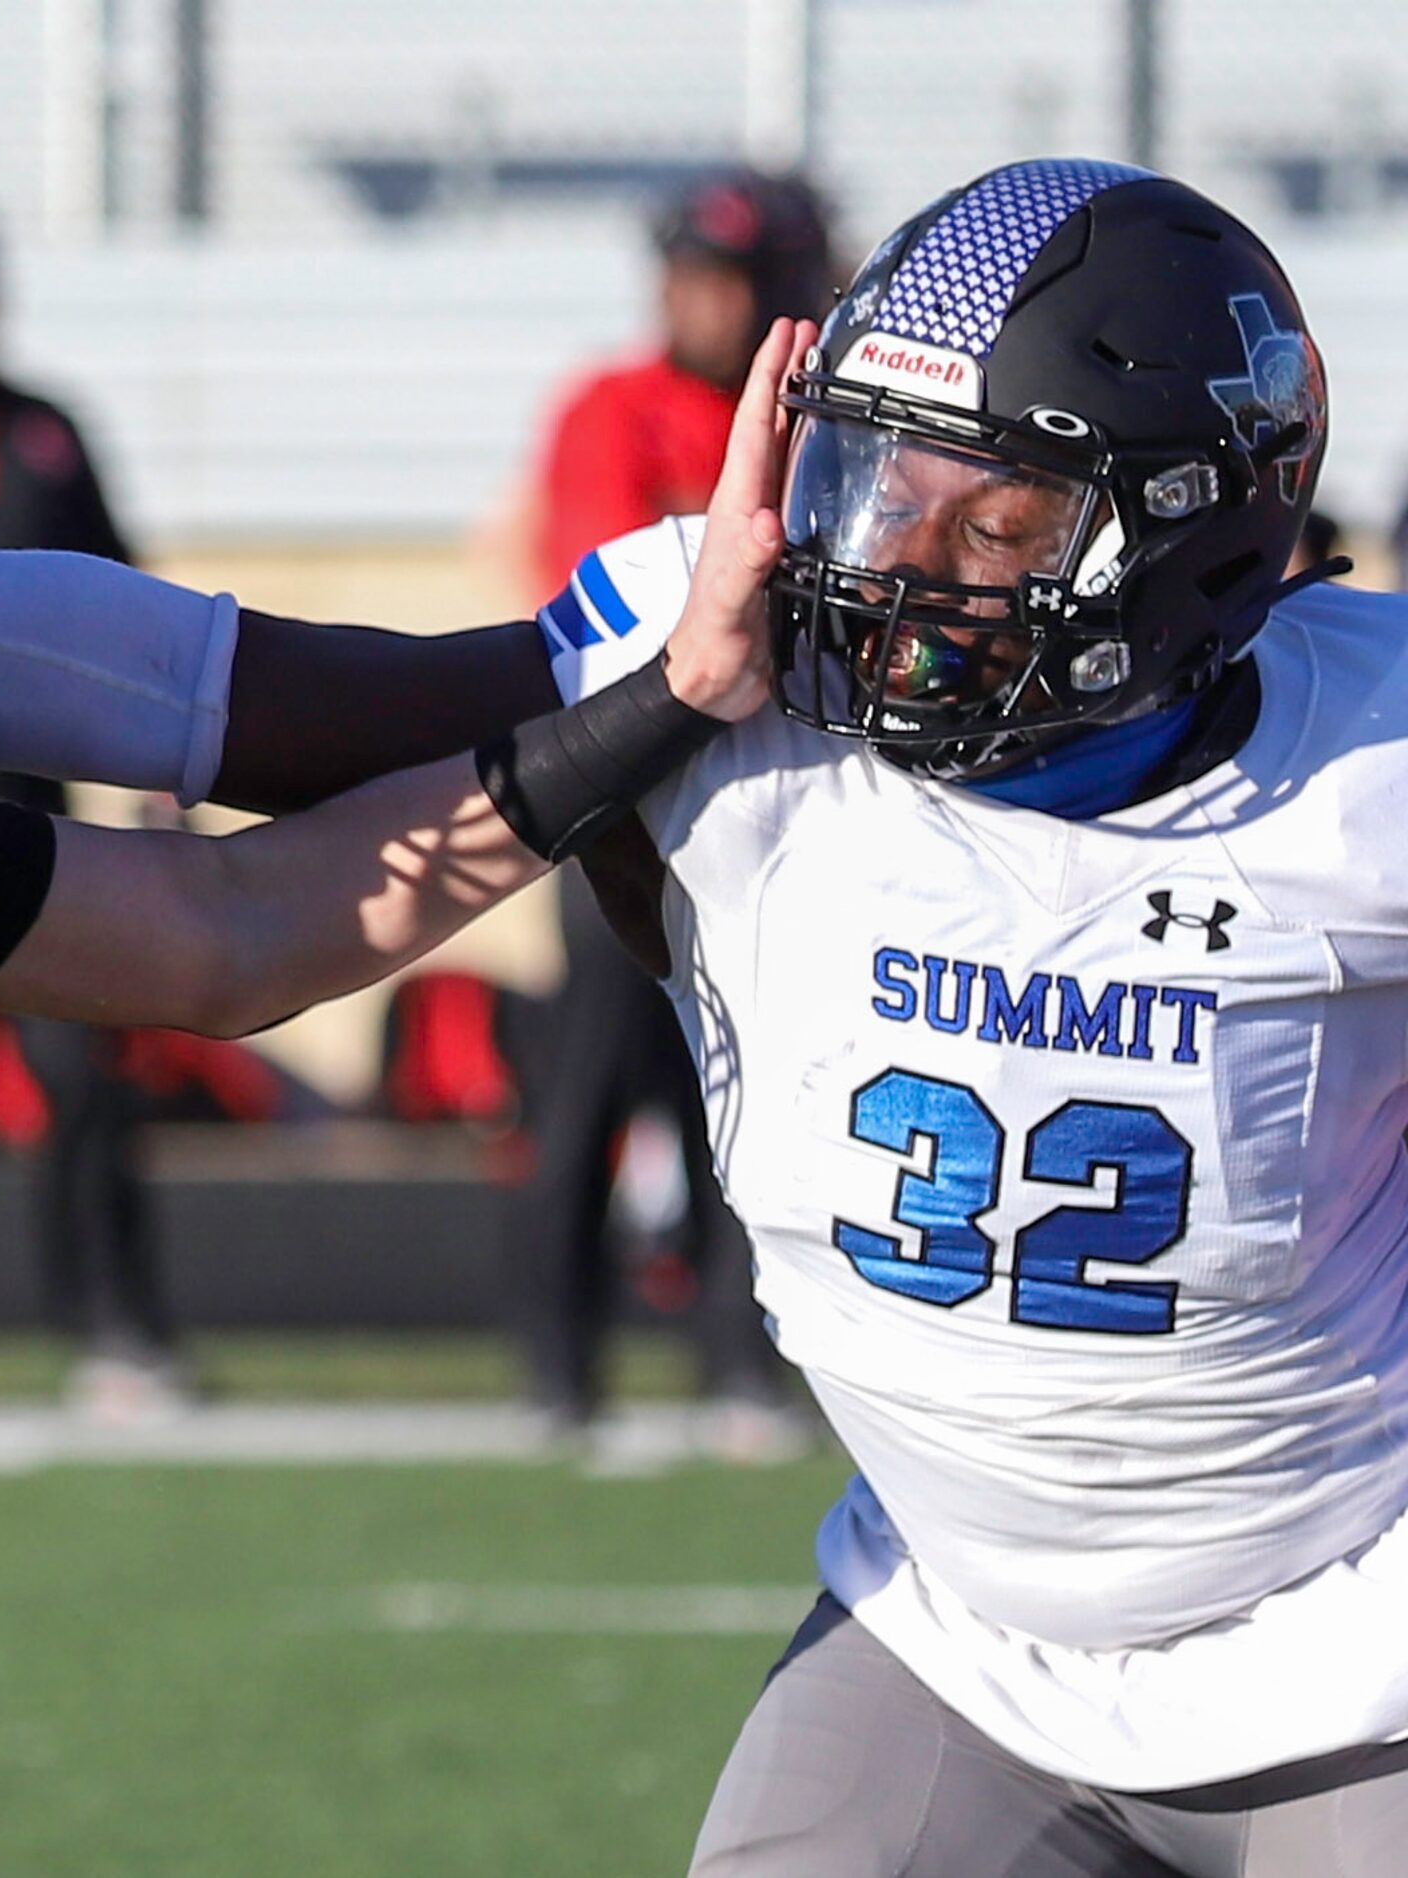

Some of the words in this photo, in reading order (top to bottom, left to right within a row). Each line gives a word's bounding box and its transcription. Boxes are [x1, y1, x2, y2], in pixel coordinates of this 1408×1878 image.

[859, 341, 964, 387] Riddell
[870, 945, 1219, 1065] SUMMIT
[832, 1065, 1196, 1335] 32
